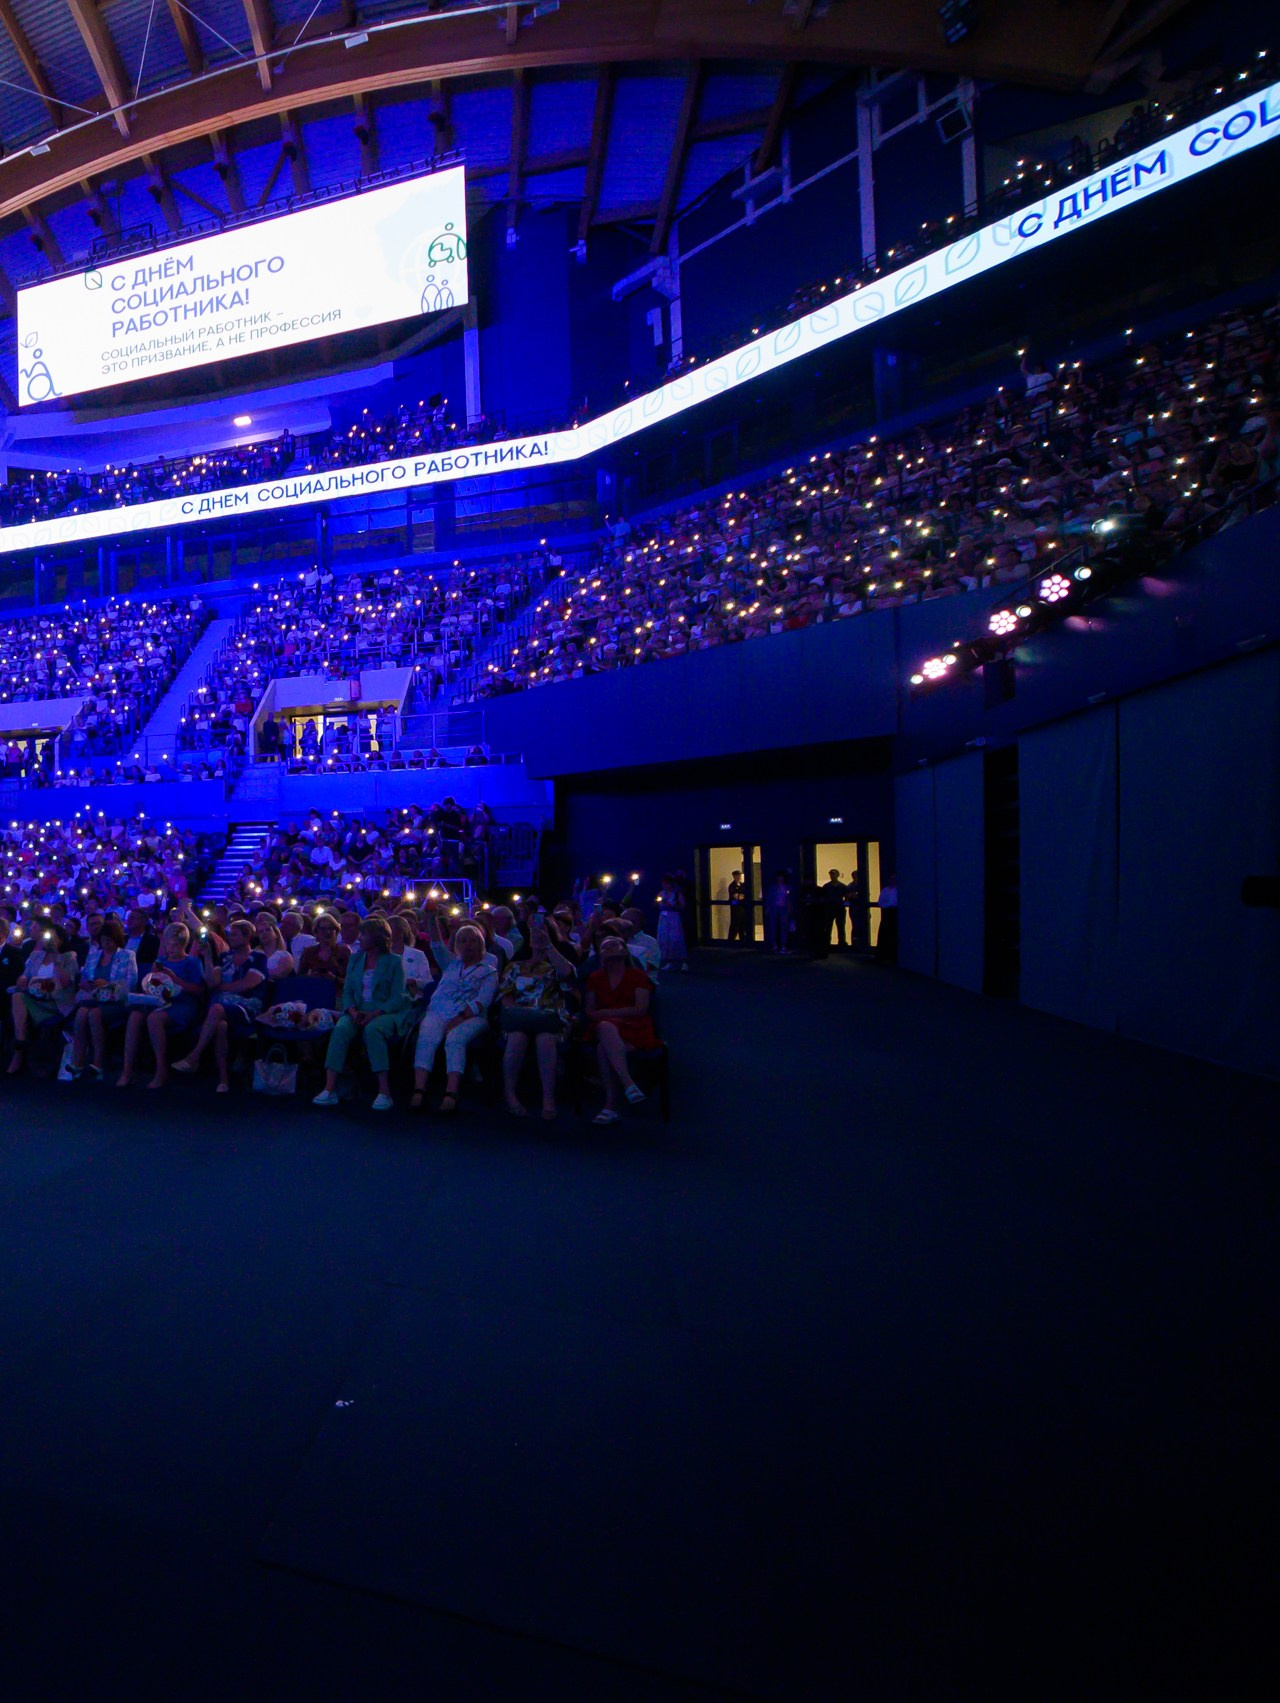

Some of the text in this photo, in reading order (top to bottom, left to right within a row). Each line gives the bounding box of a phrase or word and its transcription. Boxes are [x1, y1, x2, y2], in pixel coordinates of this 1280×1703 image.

[1018, 212, 1043, 238] С
[1053, 149, 1167, 229] ДНЁМ
[111, 255, 194, 291] С ДНЁМ
[111, 256, 285, 314] СОЦИАЛЬНОГО
[101, 329, 195, 361] СОЦИАЛЬНЫЙ
[198, 312, 272, 338] РАБОТНИК
[112, 288, 250, 338] РАБОТНИКА!
[646, 307, 663, 347] 1
[101, 309, 342, 375] ЭТО ПРИЗВАНИЕ, А НЕ ПРОФЕССИЯ
[182, 440, 549, 515] С ДНЕМ СОЦИАЛЬНОГО РАБОТНИКА!
